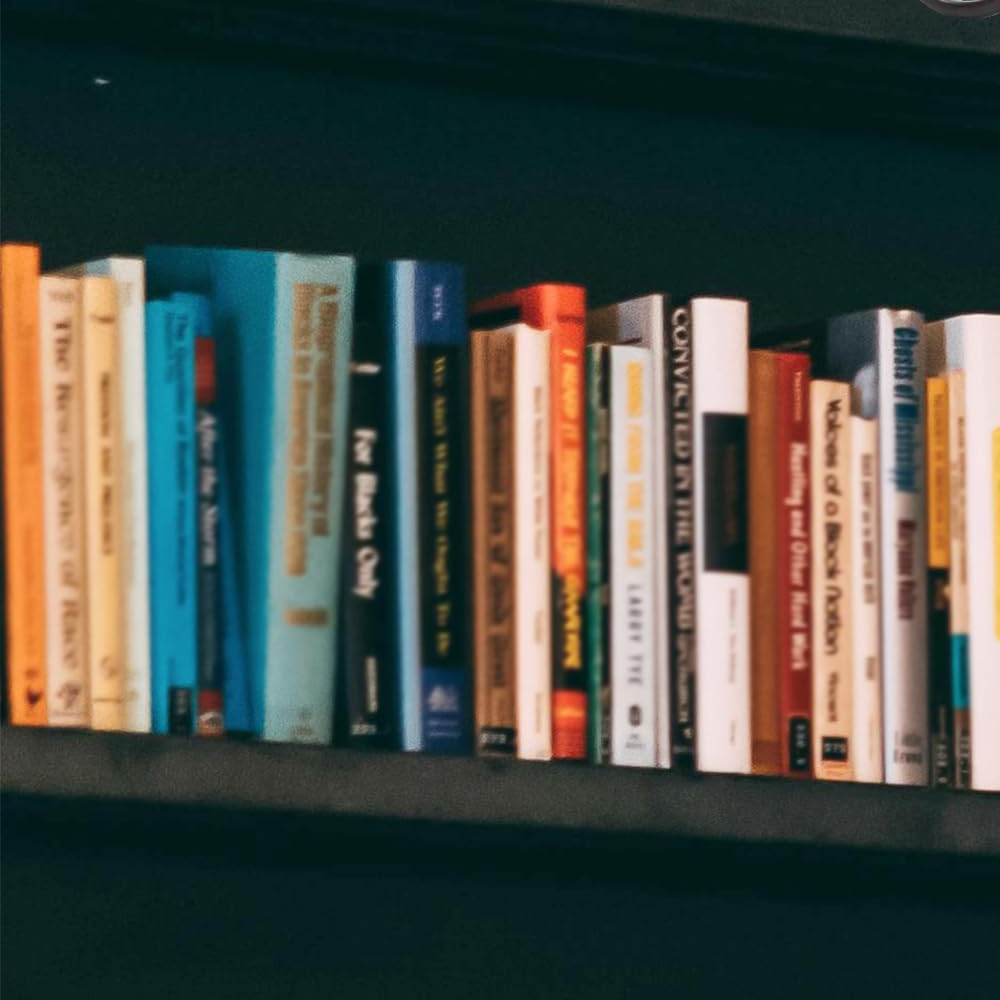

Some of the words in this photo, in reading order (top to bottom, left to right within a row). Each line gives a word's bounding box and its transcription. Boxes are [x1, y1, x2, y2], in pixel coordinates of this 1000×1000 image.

[52, 318, 73, 372] The
[893, 326, 920, 381] Ghosts
[432, 355, 447, 387] We
[671, 308, 692, 457] CONVICTED
[894, 384, 920, 402] of
[199, 409, 217, 463] After
[432, 394, 447, 436] Ain't
[823, 398, 843, 469] Voices
[52, 382, 76, 553] Resurgence
[354, 428, 377, 464] For
[432, 443, 447, 495] What
[890, 402, 920, 494] Mississippi
[199, 467, 217, 496] the
[677, 463, 693, 490] IN
[787, 442, 808, 506] Hustling
[823, 473, 843, 497] of
[354, 472, 377, 540] Blacks
[432, 500, 447, 529] We
[676, 497, 693, 545] THE
[787, 510, 808, 538] and
[825, 500, 840, 518] a
[199, 503, 217, 566] Storm
[823, 521, 843, 580] Black
[60, 559, 77, 589] of
[354, 546, 377, 599] Only
[787, 542, 808, 587] Other
[432, 603, 447, 626] To
[627, 583, 643, 644] LARRY
[677, 552, 695, 630] WOMB
[787, 590, 808, 628] Hard
[61, 599, 79, 670] Race
[823, 585, 843, 655] Nation
[627, 654, 643, 687] TYE
[787, 632, 808, 670] Work
